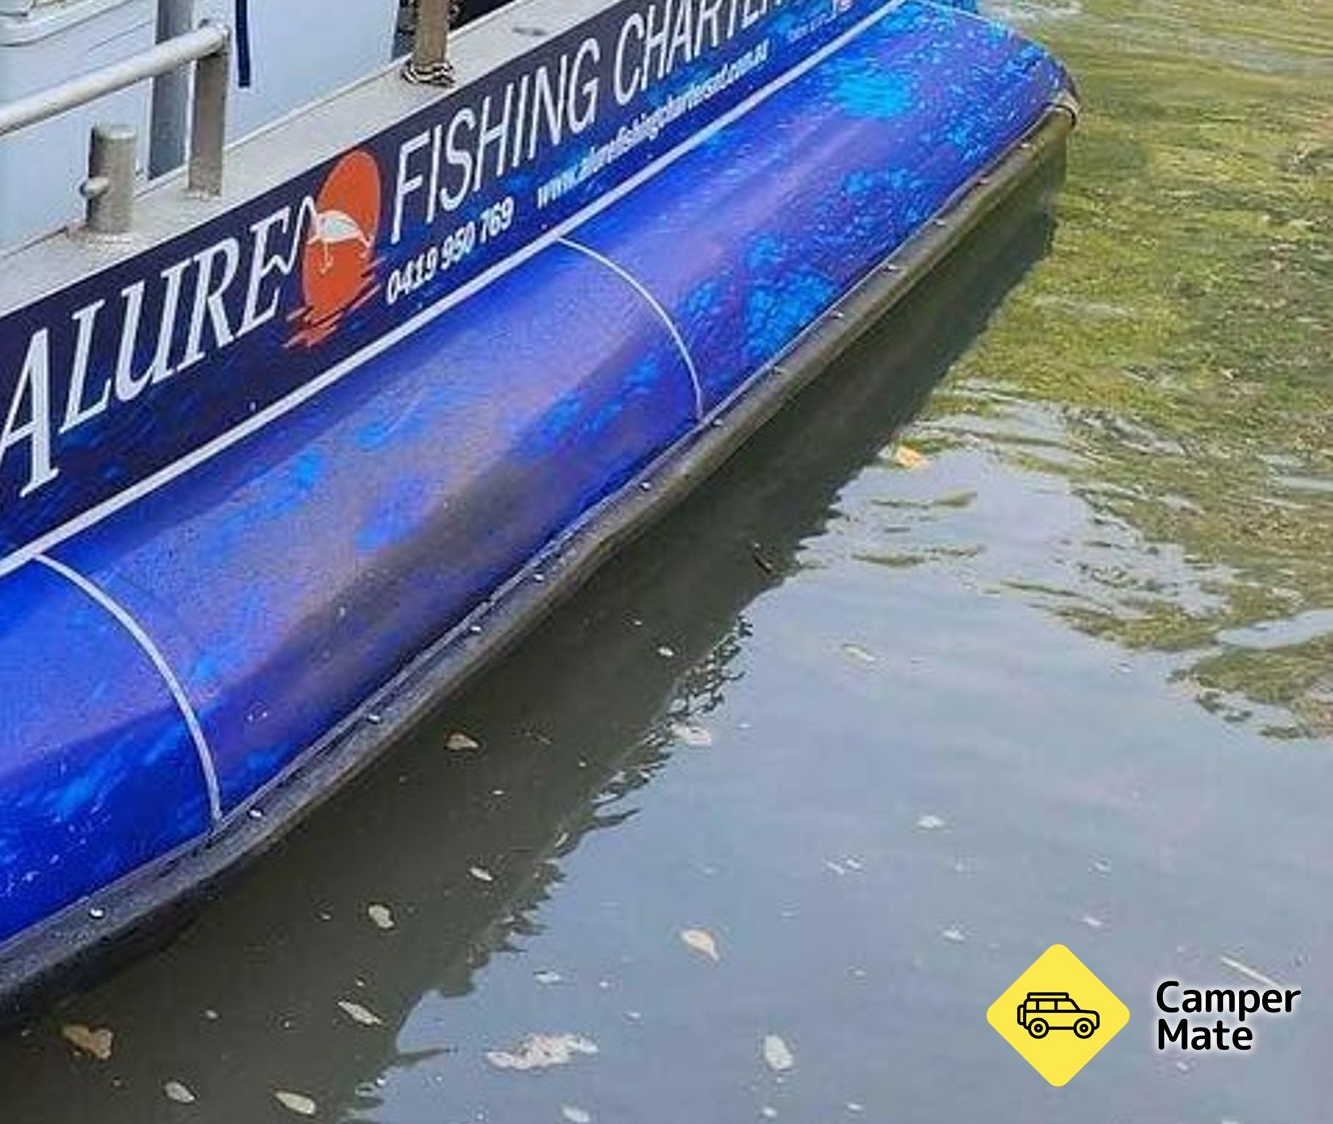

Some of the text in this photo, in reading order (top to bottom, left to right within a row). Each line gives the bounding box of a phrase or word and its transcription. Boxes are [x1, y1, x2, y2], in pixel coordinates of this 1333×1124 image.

[391, 38, 600, 245] FISHING
[387, 247, 439, 304] 0419
[440, 221, 475, 270] 950
[480, 196, 514, 243] 769
